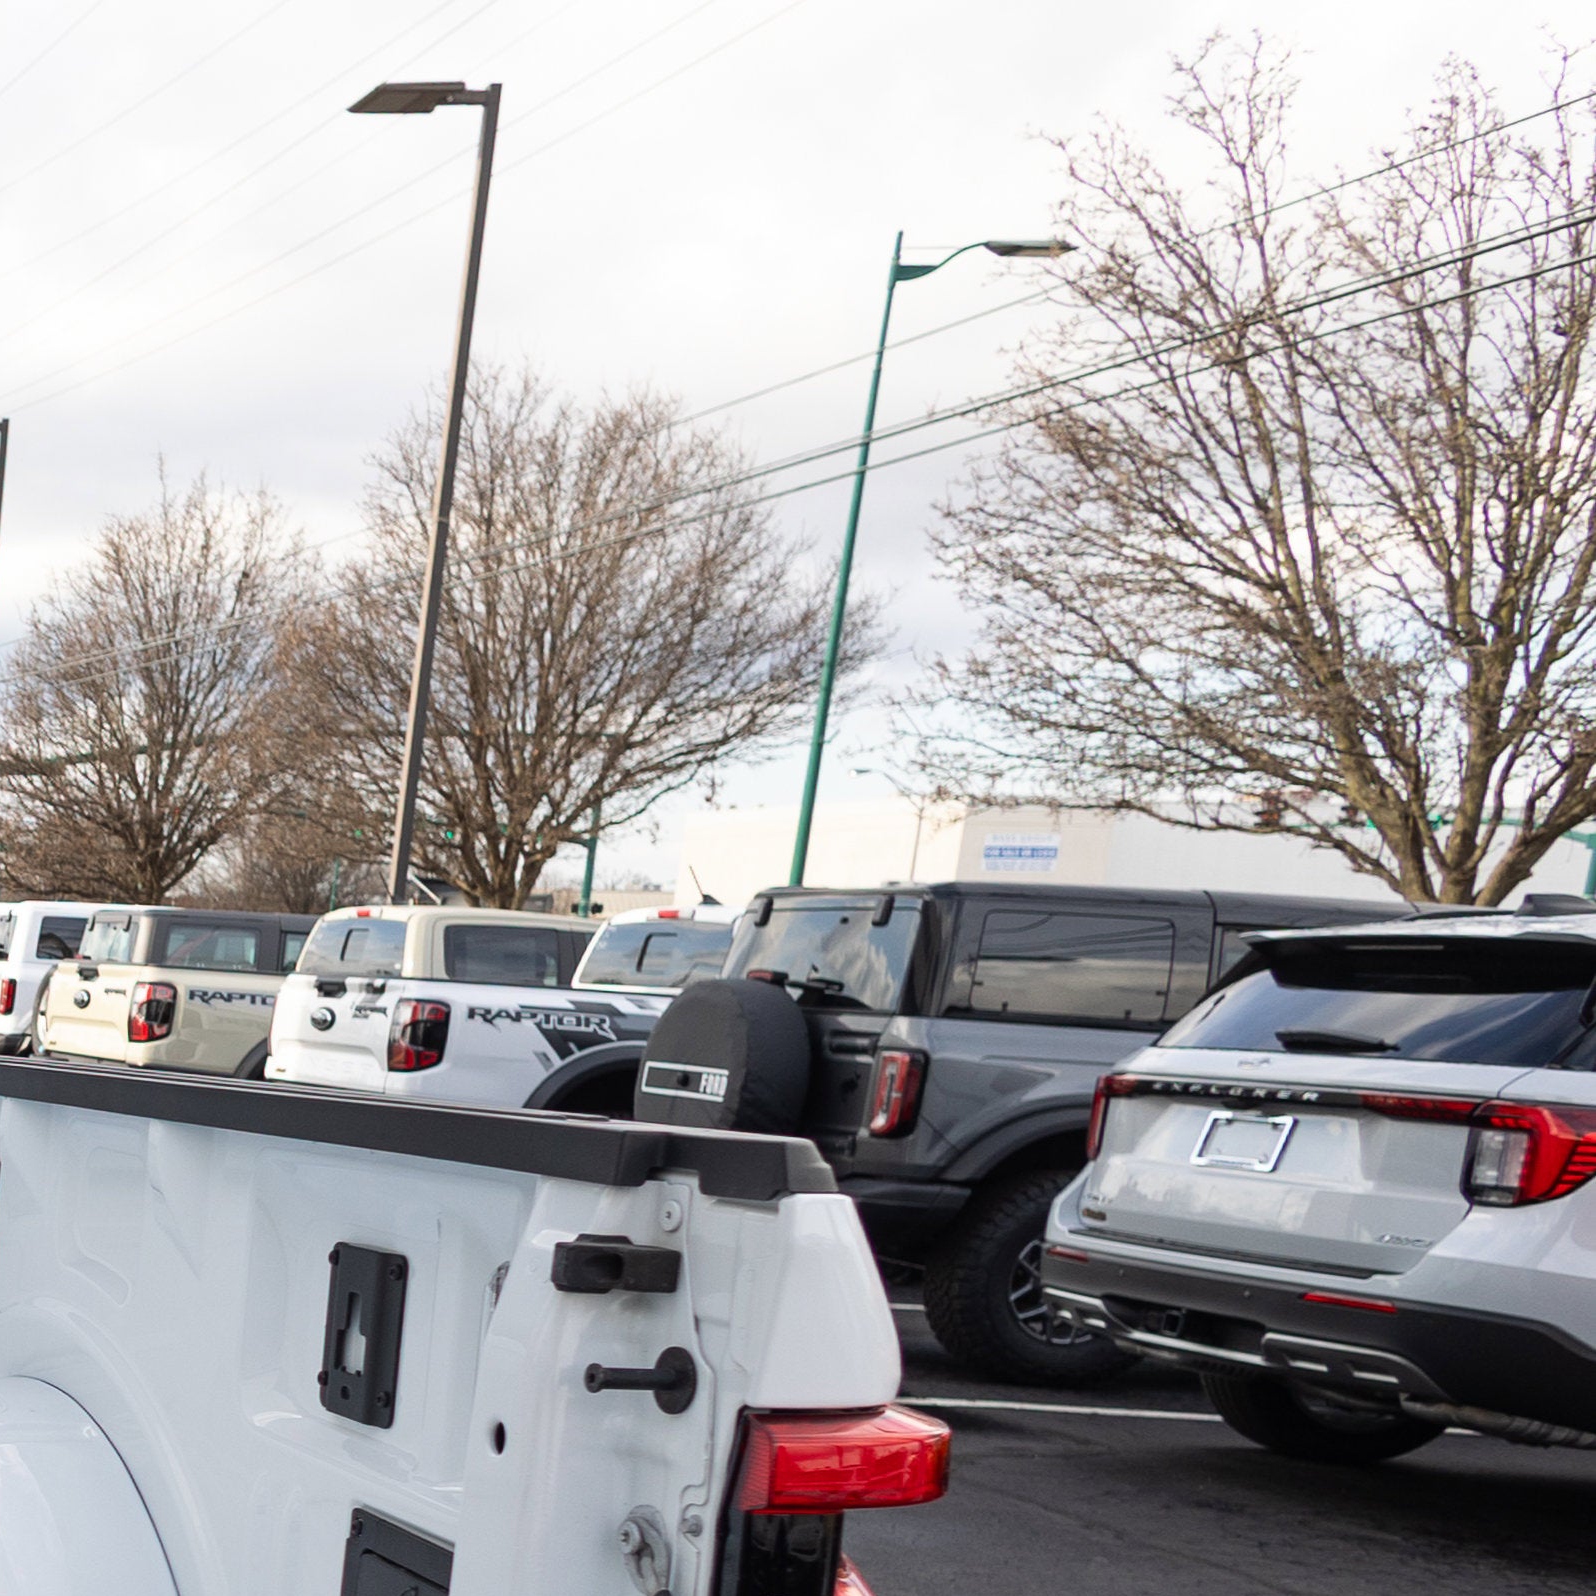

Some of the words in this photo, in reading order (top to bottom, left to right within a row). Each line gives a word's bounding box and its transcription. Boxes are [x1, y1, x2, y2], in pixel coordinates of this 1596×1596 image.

[189, 989, 275, 1009] RAPTO
[467, 1007, 617, 1041] RAPTOR
[1152, 1082, 1320, 1101] EXPLORER
